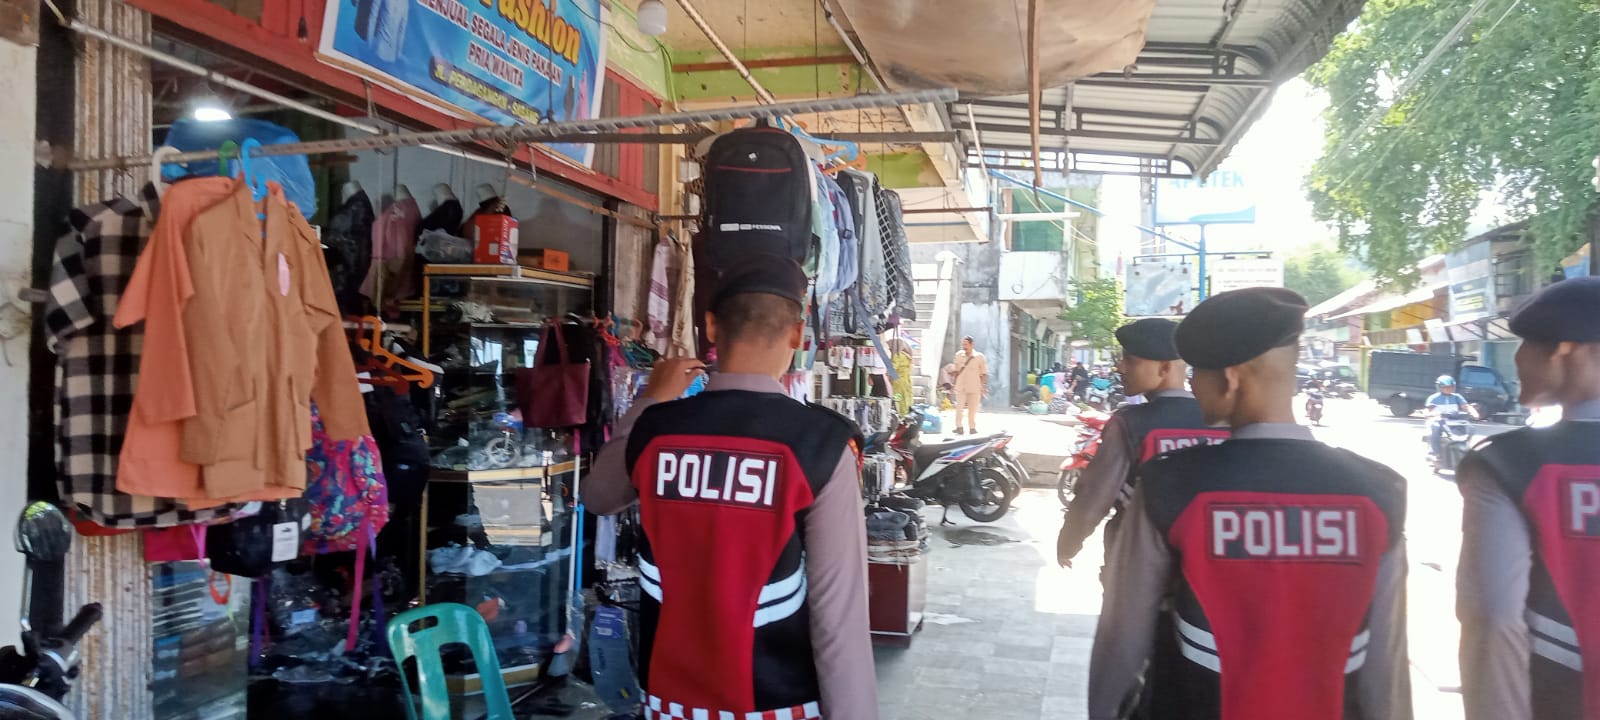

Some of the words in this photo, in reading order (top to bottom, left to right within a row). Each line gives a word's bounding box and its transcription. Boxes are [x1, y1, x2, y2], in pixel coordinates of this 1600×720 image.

[418, 0, 469, 31] NJUAL
[470, 12, 506, 53] SEGALA
[507, 35, 530, 67] JENIS
[479, 0, 581, 66] ashion
[467, 40, 490, 72] PRIA
[489, 52, 524, 89] WANITA
[656, 452, 778, 506] POLISI
[1212, 510, 1358, 556] POLISI
